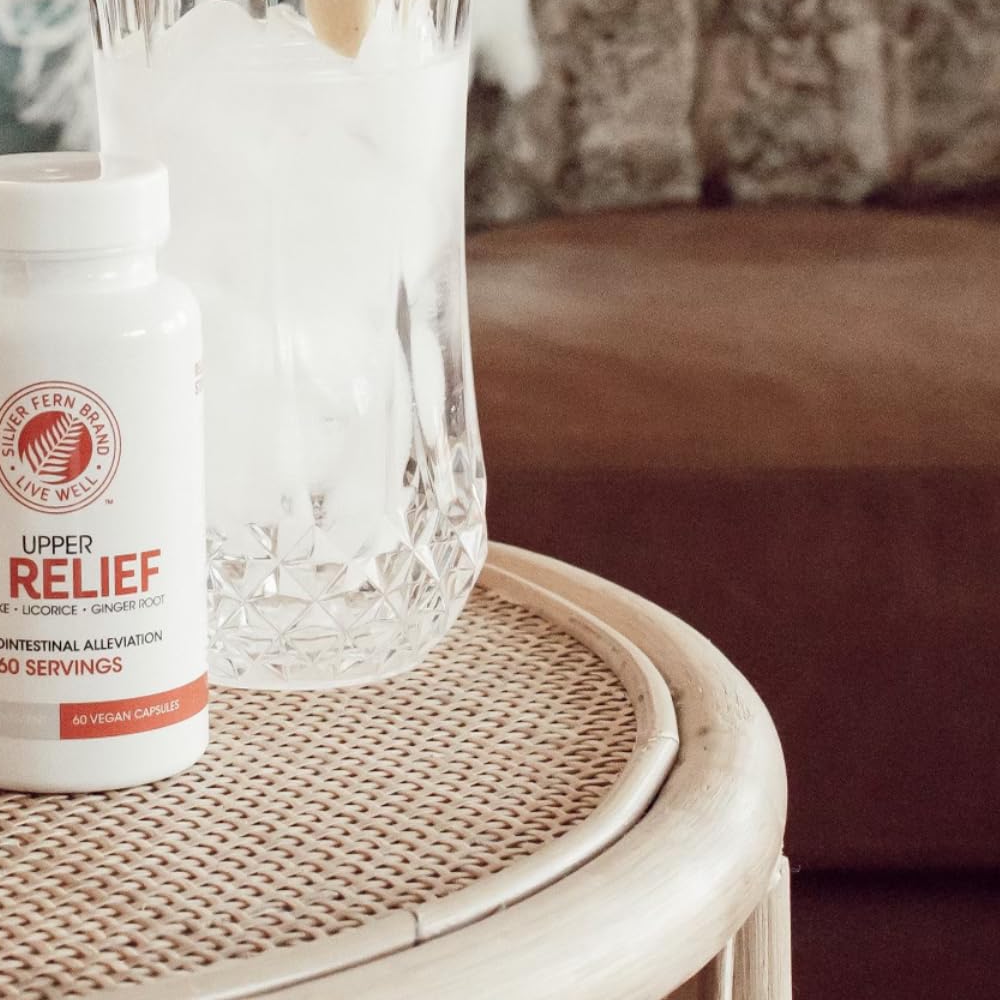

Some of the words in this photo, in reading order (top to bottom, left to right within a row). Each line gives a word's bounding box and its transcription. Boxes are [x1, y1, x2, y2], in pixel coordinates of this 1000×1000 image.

[2, 405, 29, 457] SILVER
[31, 393, 76, 410] FERN
[79, 403, 110, 456] BRAND
[16, 475, 51, 501] LIVE
[55, 475, 98, 501] WELL
[22, 535, 93, 555] UPPER
[9, 548, 161, 600] RELIEF
[22, 604, 78, 616] LICORICE
[91, 599, 136, 615] GINGER
[138, 594, 165, 609] ROOT
[83, 630, 163, 652] ALLEVIATION
[25, 656, 123, 676] SERVINGS
[72, 713, 87, 726] 60
[90, 710, 132, 725] VEGAN
[134, 699, 180, 720] CAPSULES
